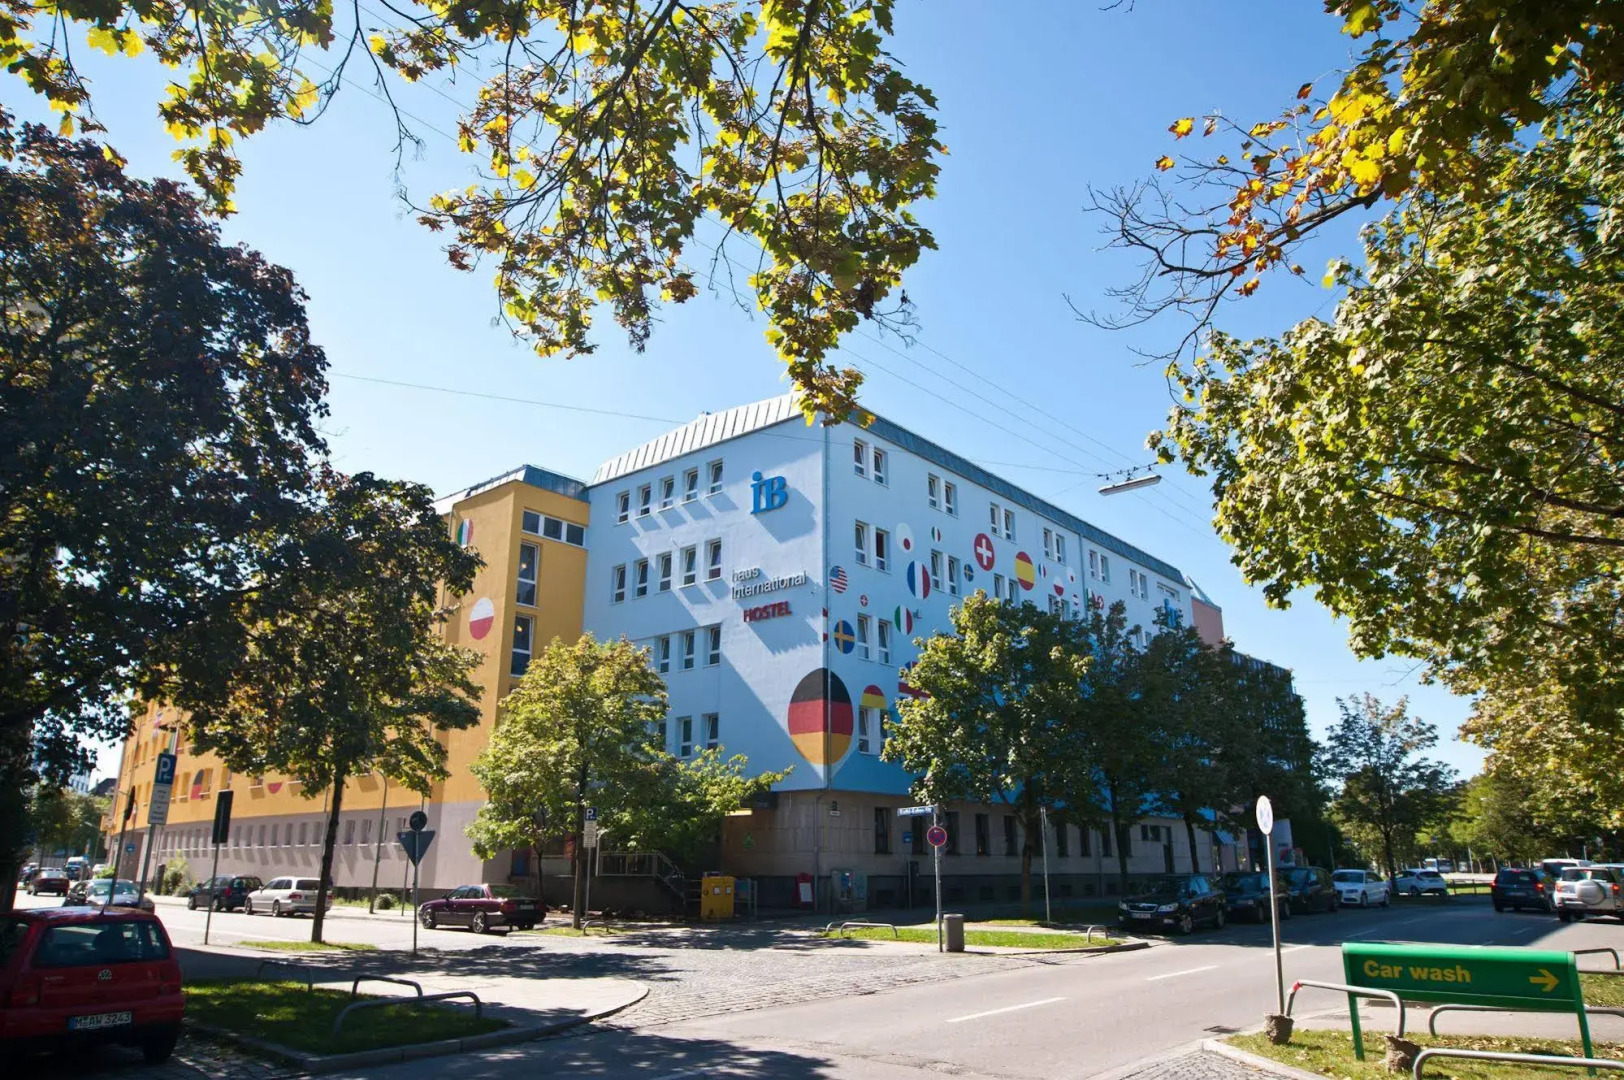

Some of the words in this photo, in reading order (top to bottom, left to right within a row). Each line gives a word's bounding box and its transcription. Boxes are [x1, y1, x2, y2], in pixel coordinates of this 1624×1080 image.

[743, 601, 792, 622] HOSTEL
[158, 757, 171, 780] P
[586, 808, 594, 820] P
[1363, 959, 1403, 978] Car
[1409, 965, 1472, 983] wash
